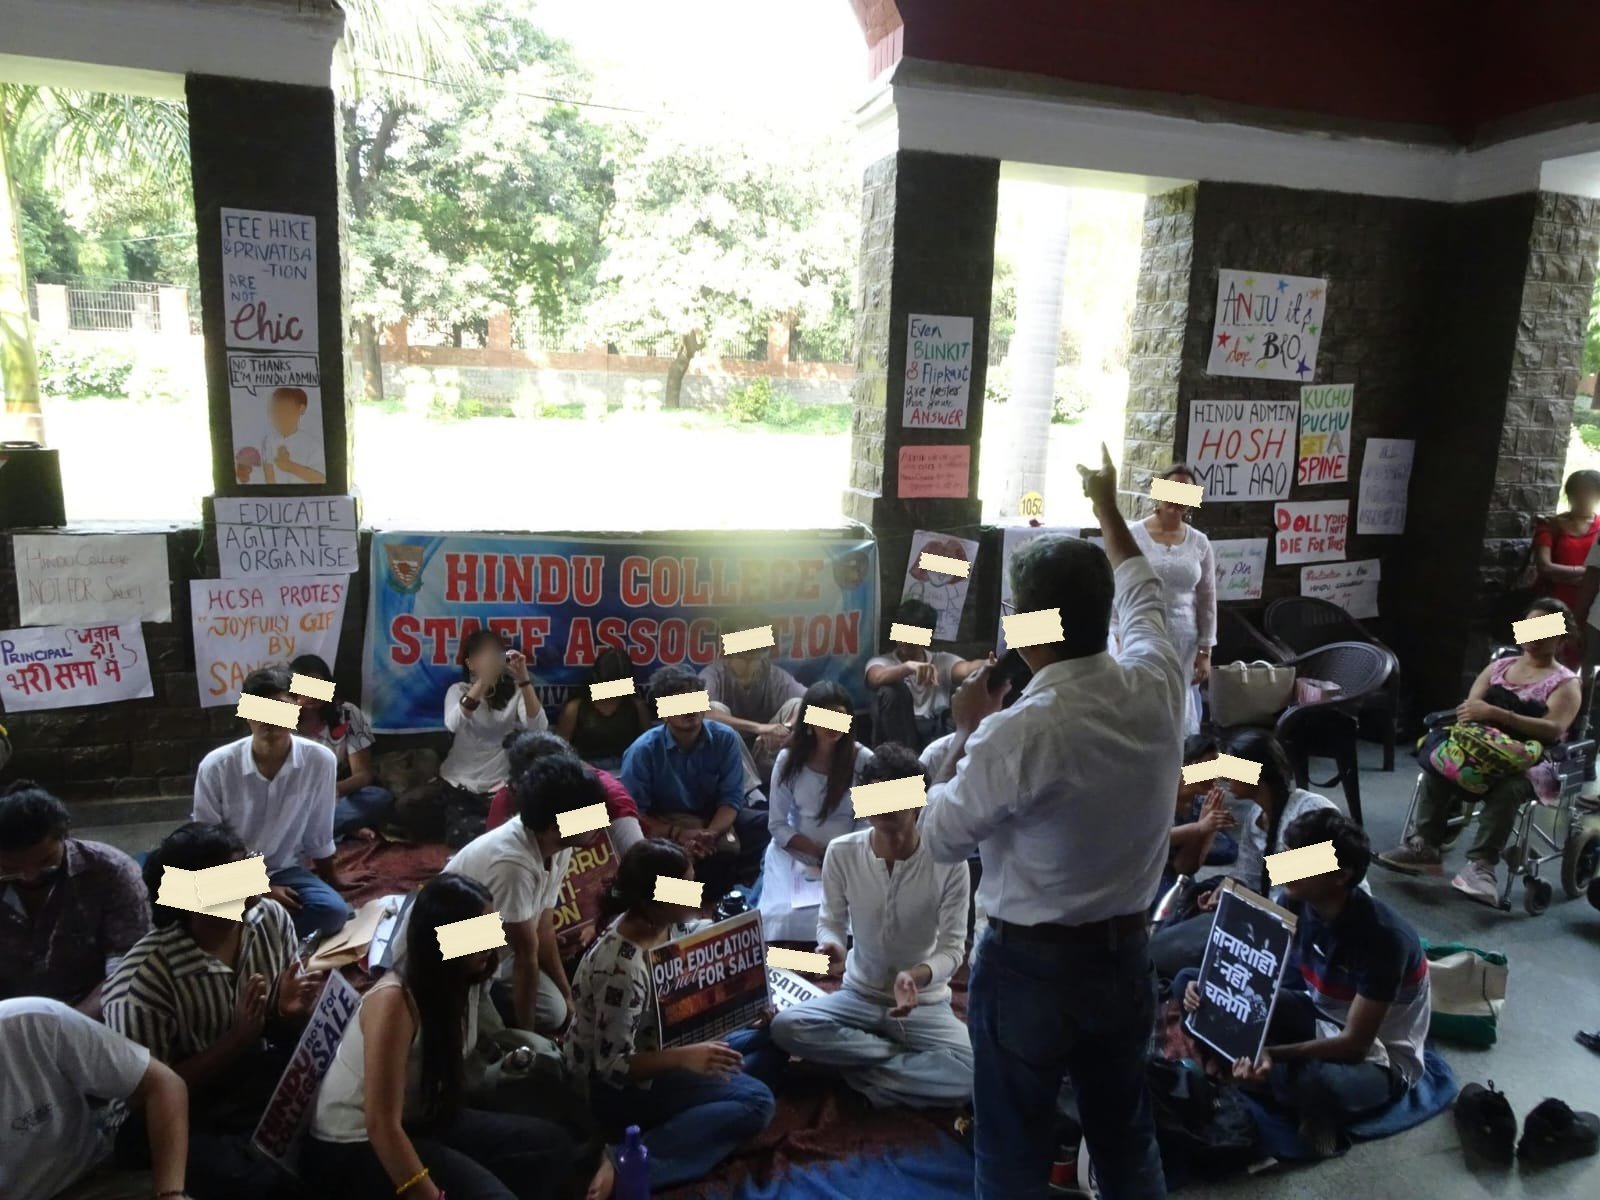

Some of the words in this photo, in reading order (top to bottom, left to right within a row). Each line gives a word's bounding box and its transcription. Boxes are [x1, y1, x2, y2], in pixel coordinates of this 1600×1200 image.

[224, 215, 262, 239] FEE
[269, 218, 312, 242] HIKE
[234, 241, 312, 262] PRIVATISA
[229, 274, 257, 290] ARE
[231, 291, 257, 302] NOT
[1223, 281, 1279, 325] ANJU
[230, 301, 304, 344] Chic
[911, 318, 942, 339] Even
[914, 340, 971, 362] BLINKIT
[232, 359, 247, 371] NO
[249, 359, 292, 373] THANKS
[255, 373, 287, 386] HINDU
[288, 371, 318, 385] ADMIN
[922, 363, 969, 385] Flipkart
[1303, 387, 1352, 410] KUCHU
[910, 408, 964, 427] ANSWER
[1194, 403, 1244, 423] HINDU
[1249, 403, 1296, 424] ADMIN
[1301, 411, 1350, 435] PUCHU
[1198, 428, 1287, 462] HOSH
[1193, 463, 1240, 497] MAI
[1249, 461, 1287, 496] AAO
[1298, 455, 1347, 483] SPINE
[239, 499, 341, 525] EDUCATE
[225, 526, 331, 550] AGITATE
[1280, 537, 1303, 554] DIE
[1307, 537, 1326, 553] FOR
[239, 547, 350, 572] ORGANISE
[28, 578, 61, 606] NOT
[66, 577, 96, 603] FOR
[443, 552, 605, 607] HINDU
[619, 555, 826, 608] COLLEGE
[208, 588, 264, 610] HCSA
[268, 636, 297, 658] BY
[563, 608, 862, 667] ASSOCTION
[654, 957, 684, 985] OUR
[687, 926, 762, 972] EDUCATION
[1212, 926, 1278, 978] तानाशाही
[698, 962, 725, 990] FOR
[728, 946, 763, 976] SALE
[1219, 960, 1253, 992] नहीं
[768, 968, 818, 1002] SATIO
[1204, 980, 1252, 1024] चलेगी
[304, 1020, 323, 1049] not
[310, 987, 356, 1071] SALE
